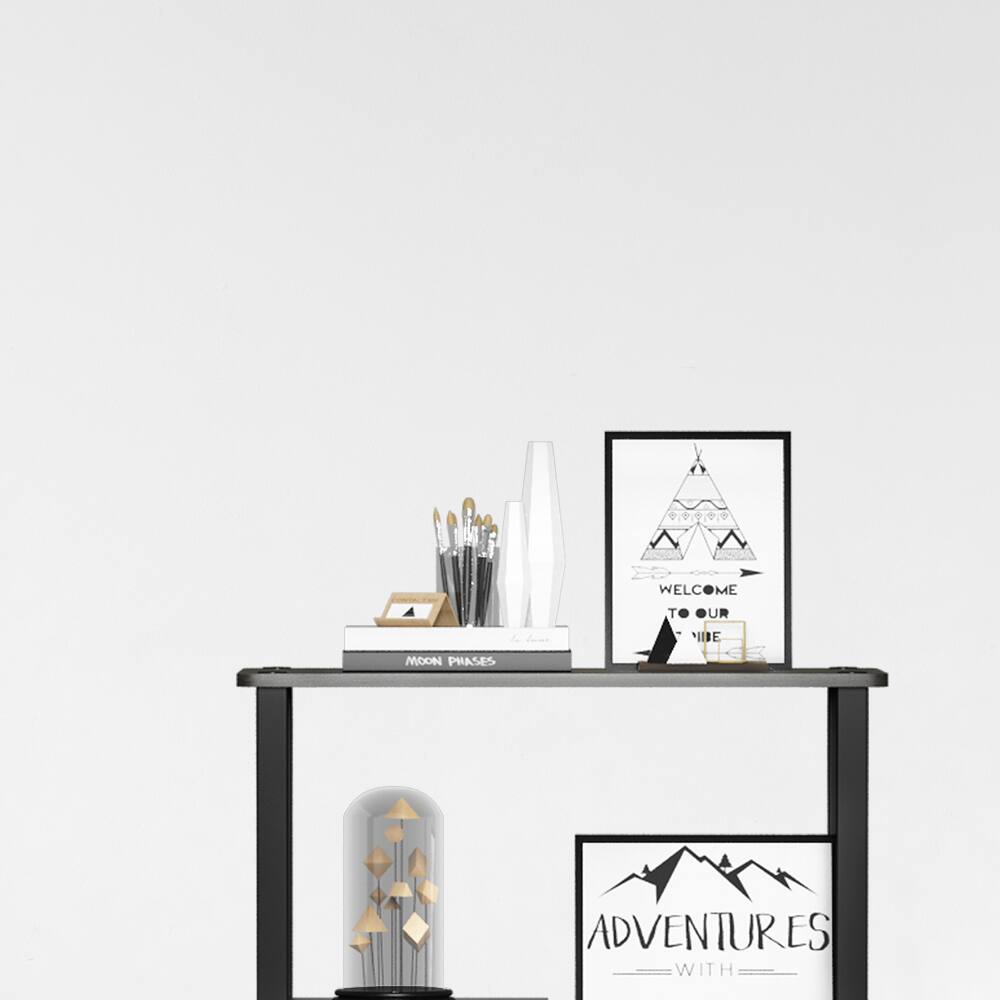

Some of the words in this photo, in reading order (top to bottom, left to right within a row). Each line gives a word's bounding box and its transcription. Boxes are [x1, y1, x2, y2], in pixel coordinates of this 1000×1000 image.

[659, 584, 738, 596] WELCOME
[668, 608, 690, 619] TO
[695, 608, 729, 619] OUR
[405, 655, 443, 667] MOON
[448, 655, 497, 667] PHASES
[587, 912, 831, 951] ADVENTURES
[675, 962, 734, 977] WITH
